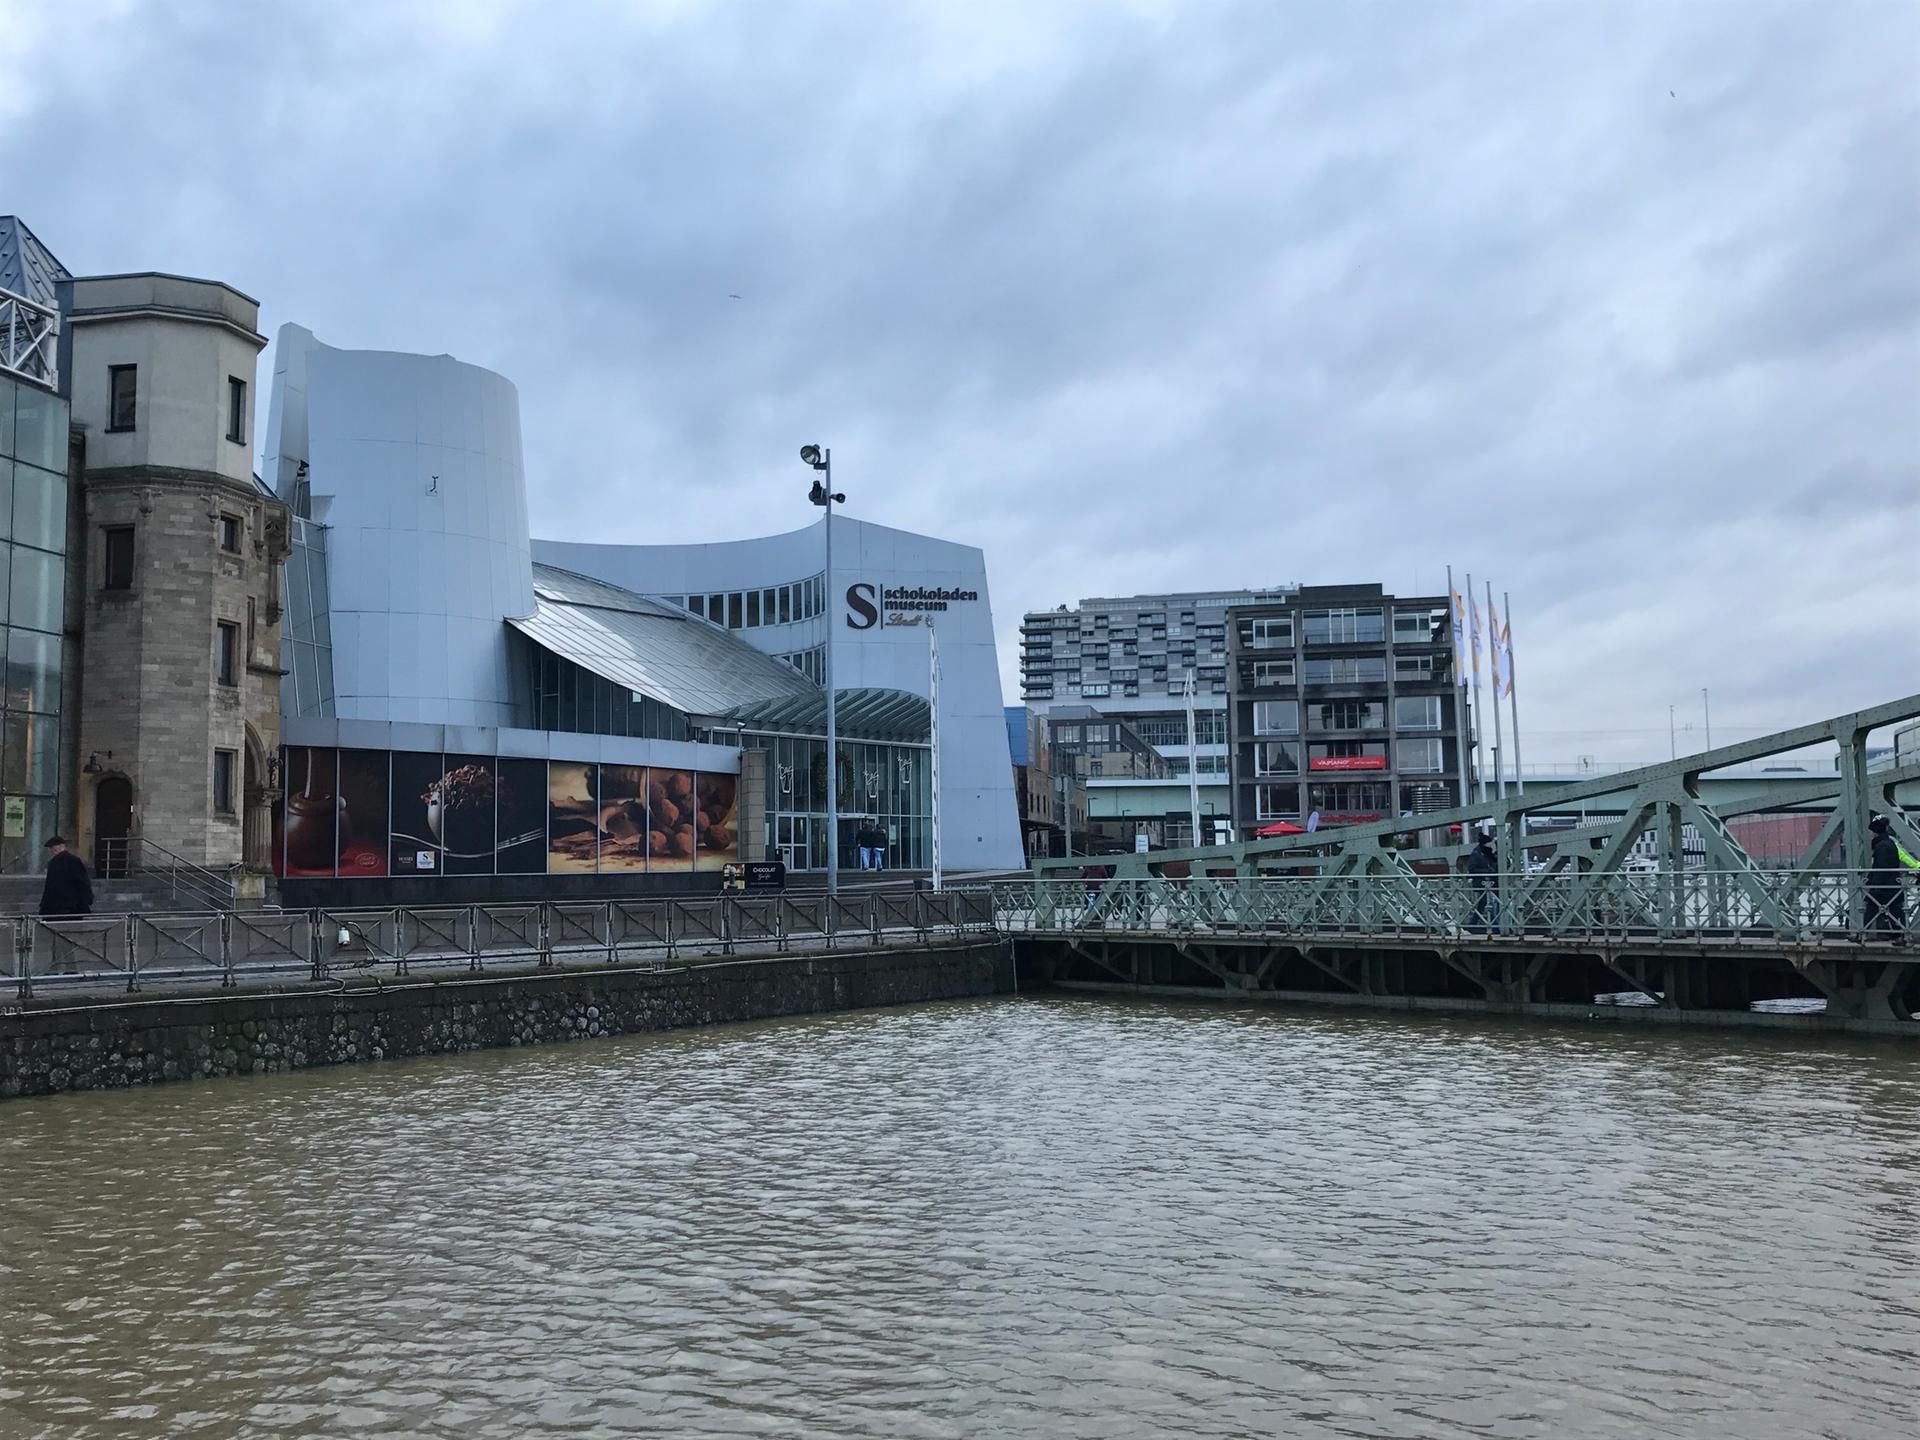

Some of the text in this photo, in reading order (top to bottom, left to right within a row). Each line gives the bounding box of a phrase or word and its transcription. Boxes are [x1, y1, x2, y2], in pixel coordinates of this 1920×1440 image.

[884, 586, 978, 600] schokoladen
[846, 583, 878, 630] S
[884, 600, 947, 611] museum
